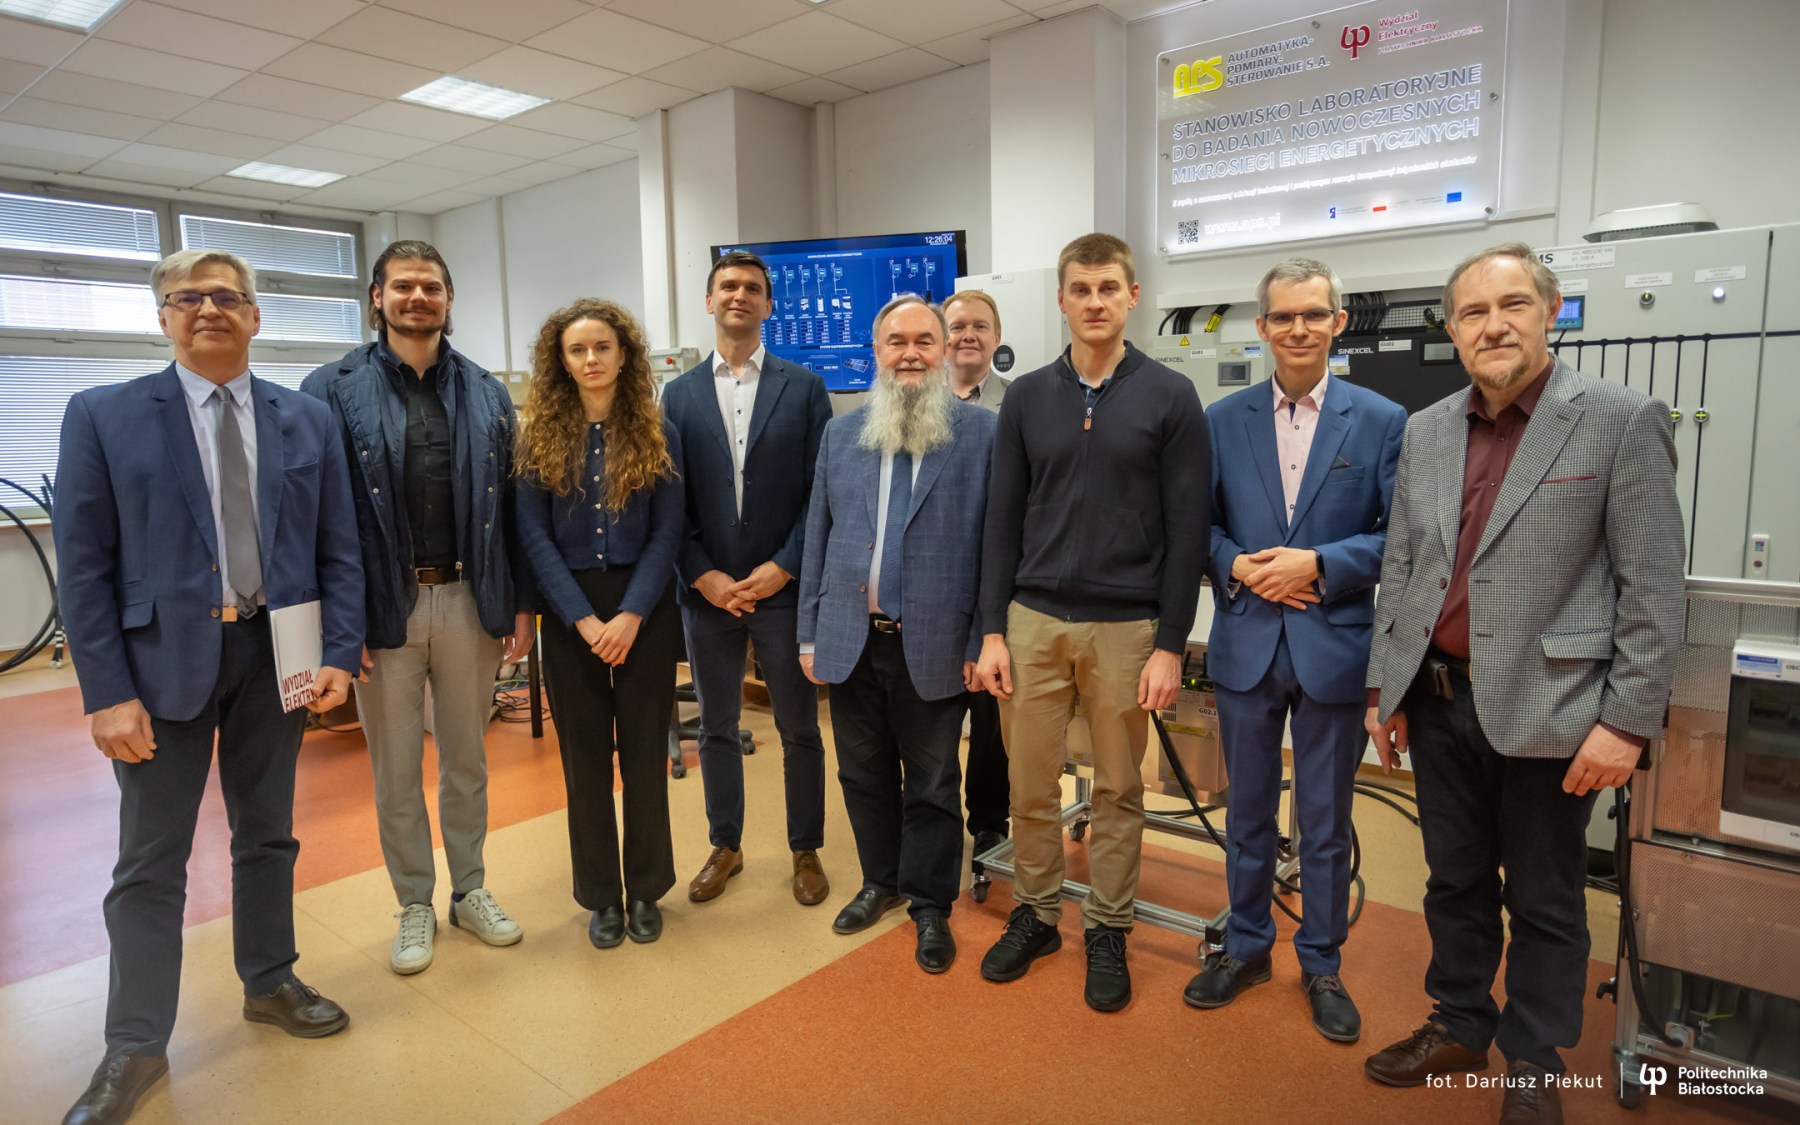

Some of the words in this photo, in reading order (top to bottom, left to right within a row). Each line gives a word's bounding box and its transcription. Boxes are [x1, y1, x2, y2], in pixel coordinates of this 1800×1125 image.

[1377, 20, 1439, 42] Elektryczny
[1378, 10, 1419, 28] Wydział
[1227, 35, 1314, 64] AUTOMATYKA-
[1173, 55, 1223, 99] APS
[1226, 61, 1303, 87] STEROWANIE
[1305, 56, 1331, 71] S.A.
[1227, 54, 1284, 75] POMIARY-
[1173, 103, 1292, 141] STANOWISKO
[1299, 64, 1482, 117] LABORATORYJNE
[1172, 143, 1197, 163] DO
[1203, 127, 1285, 157] BADANIA
[1291, 90, 1480, 142] NOWOCZESNYCH
[1172, 152, 1275, 185] MIKROSIECI
[1279, 117, 1479, 168] ENERGETYCZNYCH
[925, 235, 953, 244] 12:26:04
[1337, 347, 1374, 355] SINEXCEL
[282, 669, 314, 695] WYDZIAŁ
